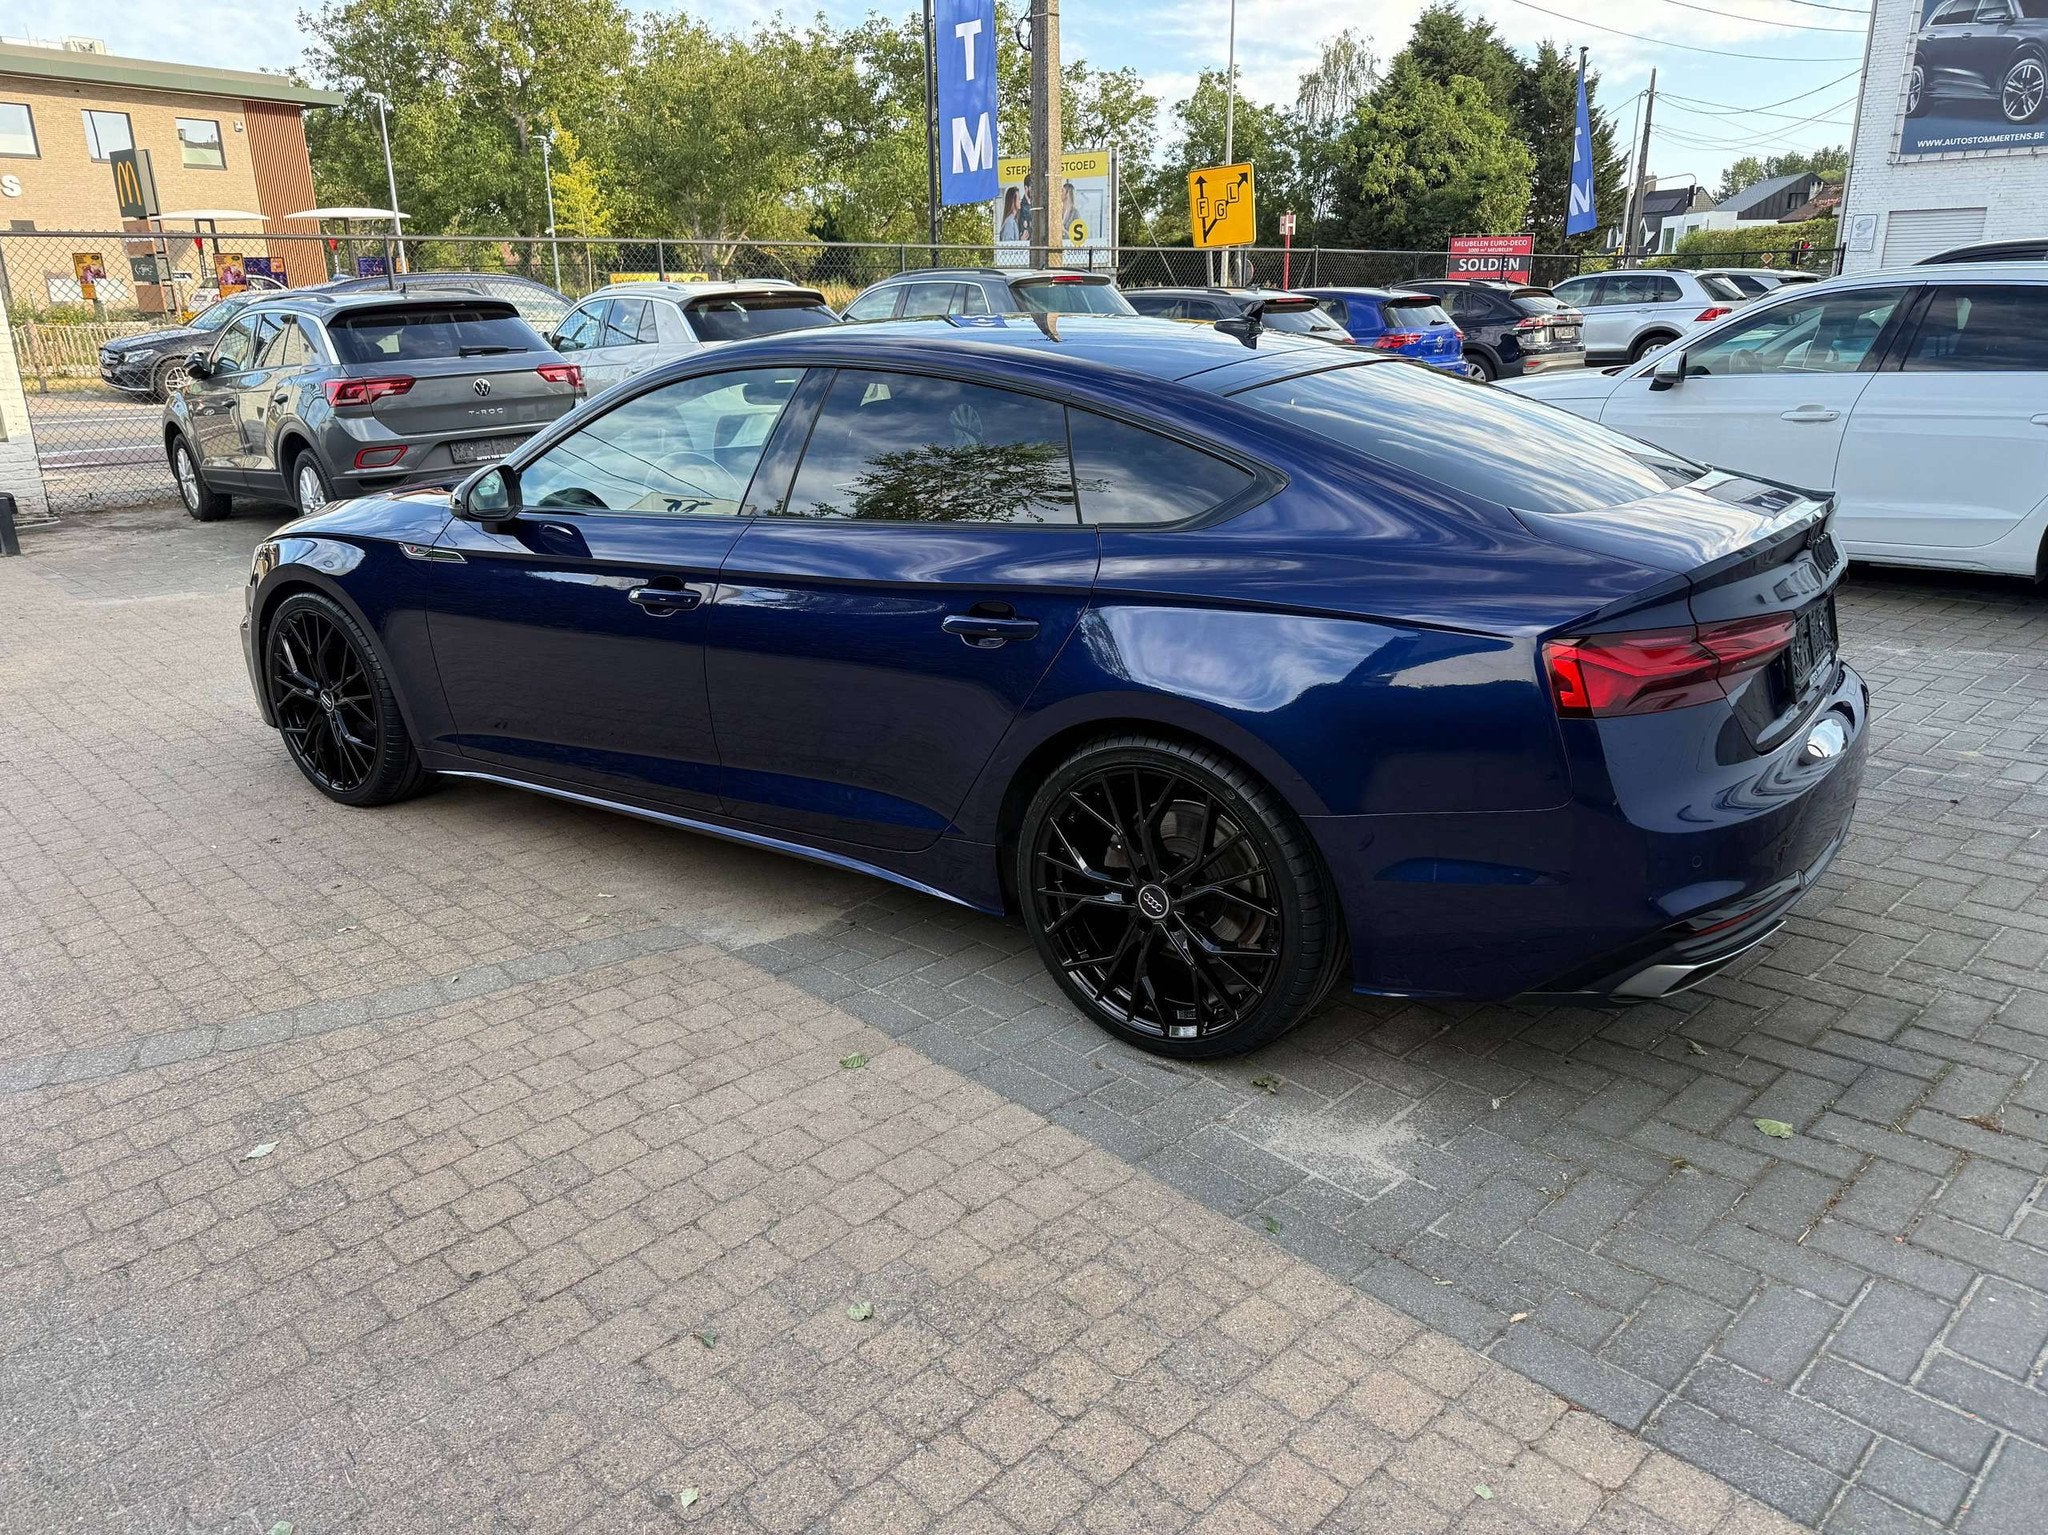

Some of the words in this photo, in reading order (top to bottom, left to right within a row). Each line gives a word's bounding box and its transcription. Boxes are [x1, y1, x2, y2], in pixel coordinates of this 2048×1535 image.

[1917, 131, 2045, 148] WWW.AUTOSTOMMERTENS.BE
[1229, 186, 1237, 200] L
[1199, 201, 1206, 215] F
[1216, 203, 1225, 217] G
[1073, 223, 1084, 241] S
[1458, 257, 1520, 271] SOLDEN
[468, 407, 504, 415] T-ROC
